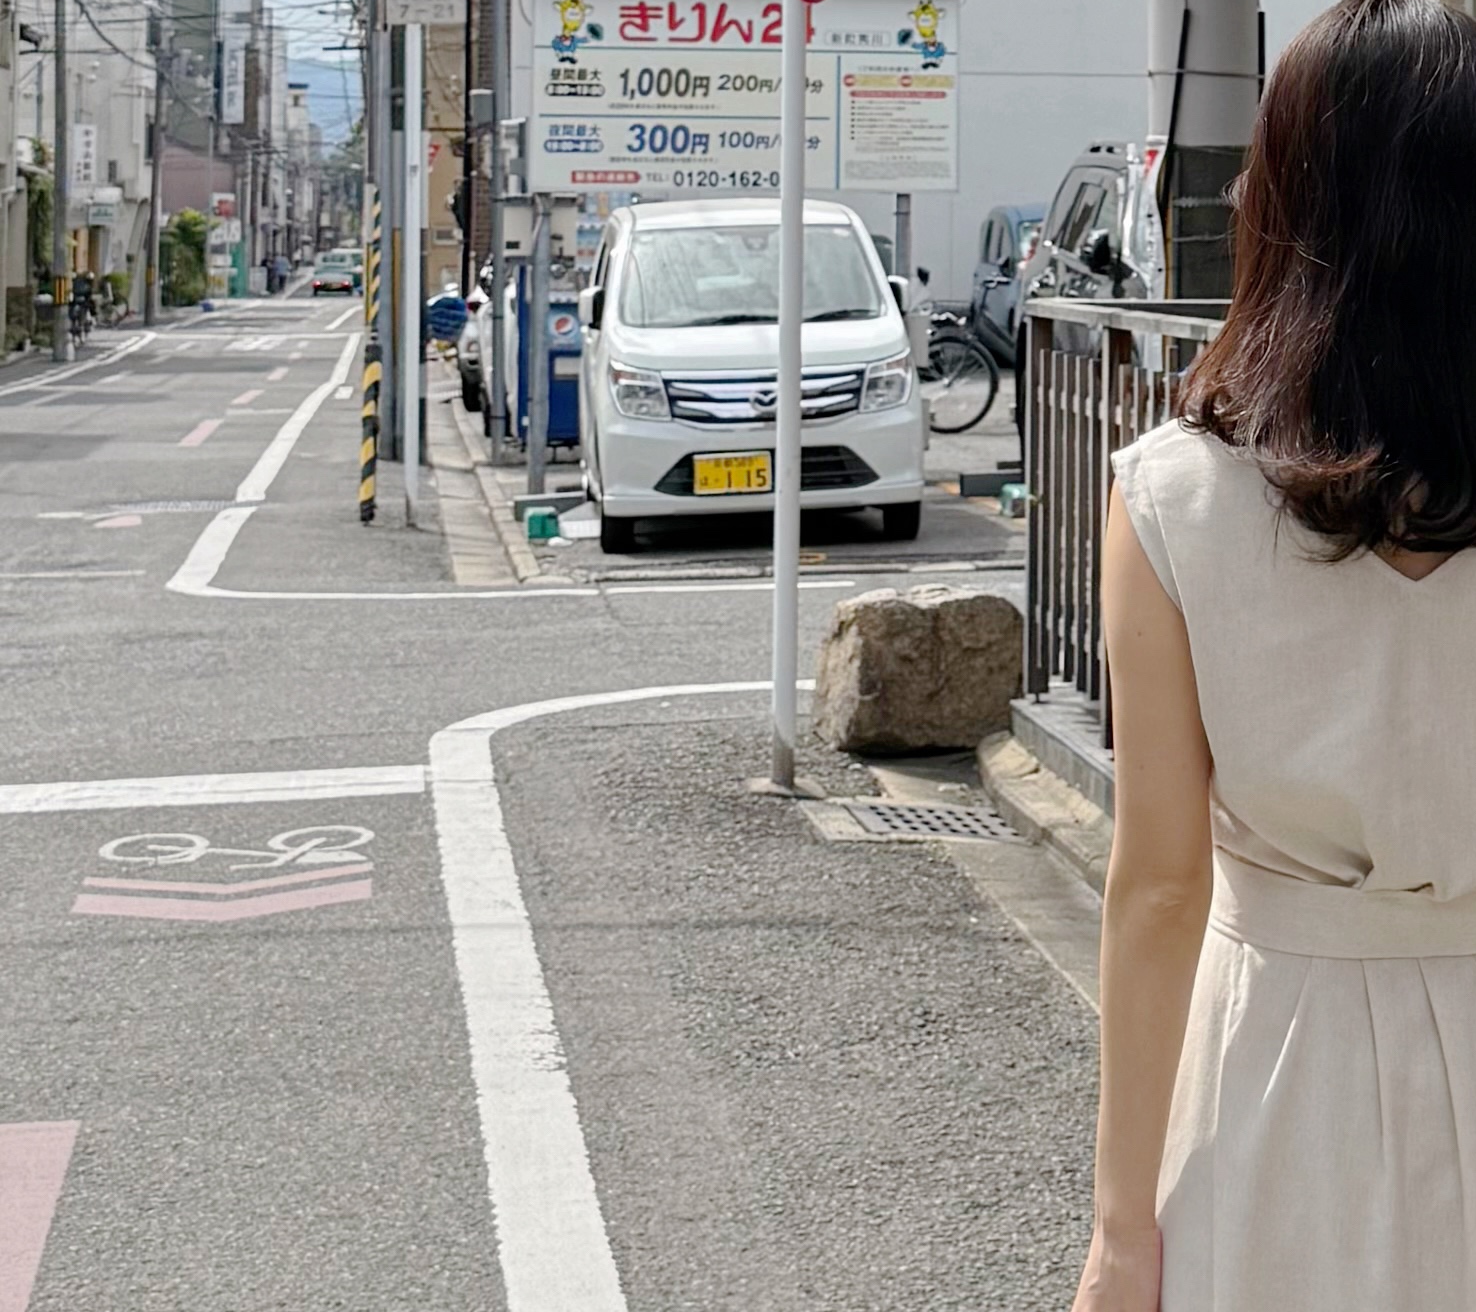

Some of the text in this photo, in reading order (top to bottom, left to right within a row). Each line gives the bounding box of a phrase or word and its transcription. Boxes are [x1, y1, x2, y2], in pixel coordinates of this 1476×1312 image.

[618, 0, 815, 44] きりん2
[619, 67, 711, 100] 1,000円
[626, 123, 710, 155] 300円
